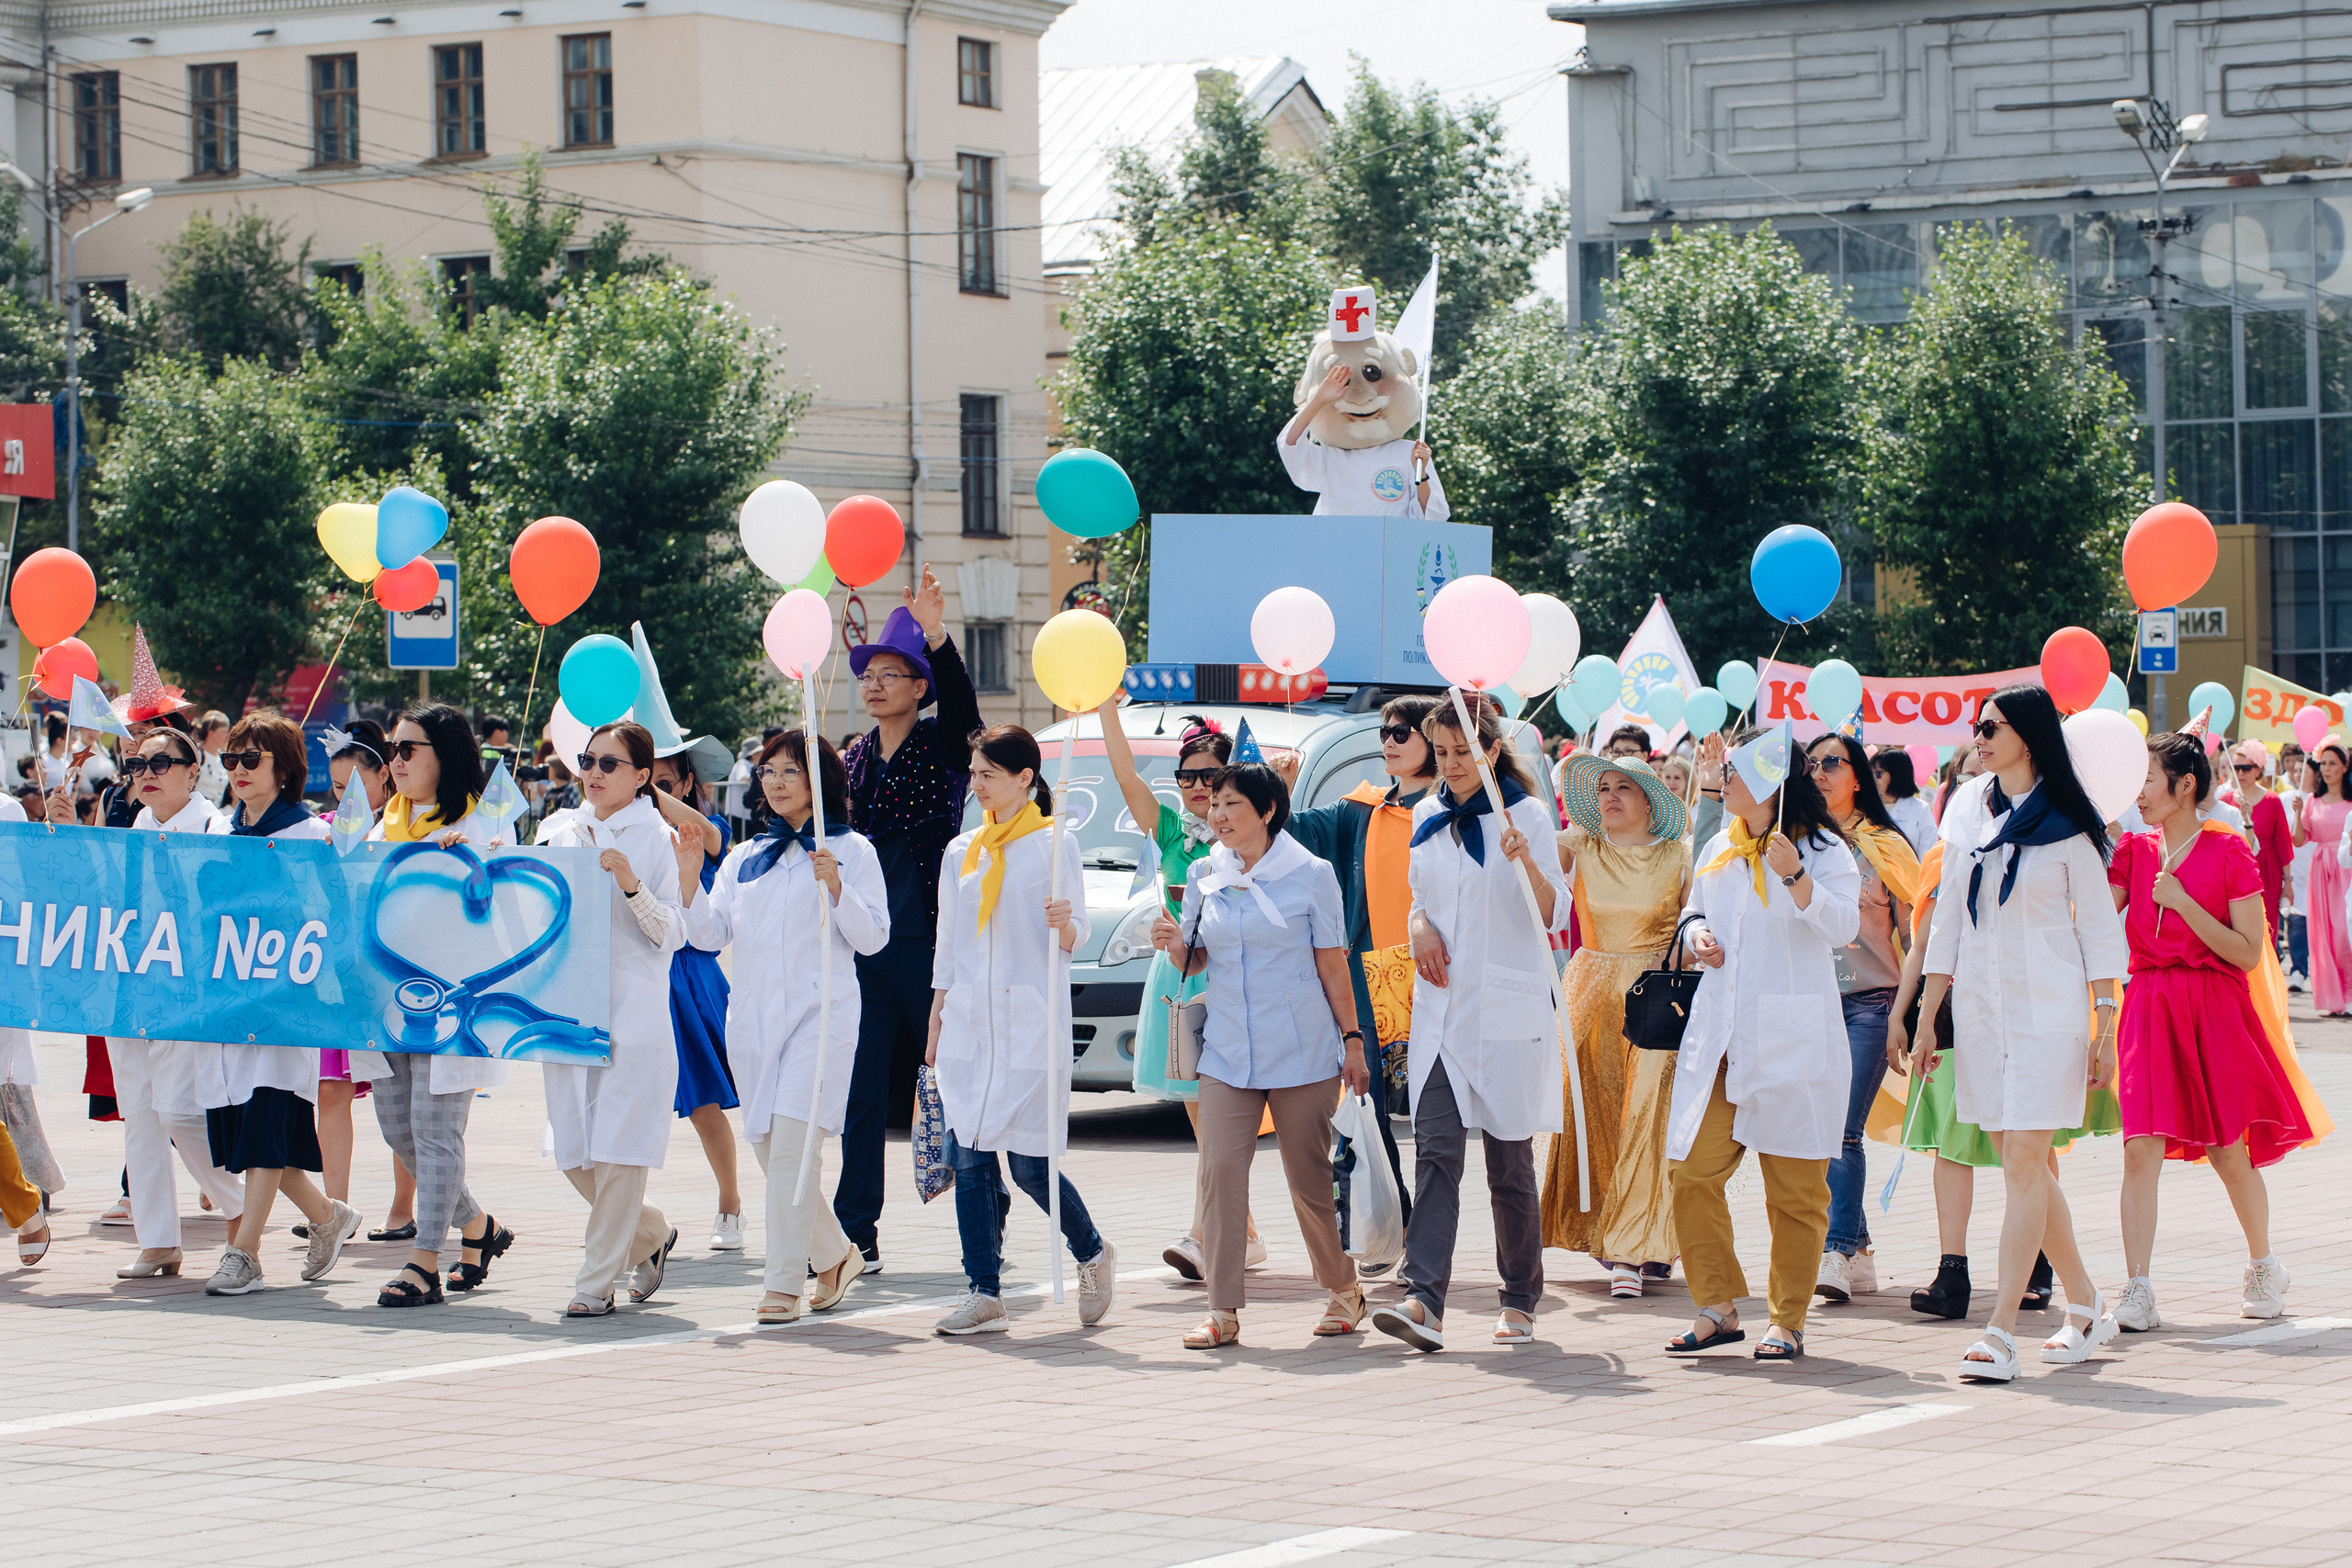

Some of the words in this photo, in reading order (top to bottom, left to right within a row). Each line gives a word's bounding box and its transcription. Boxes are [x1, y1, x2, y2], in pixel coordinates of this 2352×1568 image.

[1403, 650, 1431, 664] ПОЛИК
[0, 900, 184, 977] НИКА
[211, 915, 327, 986] №6
